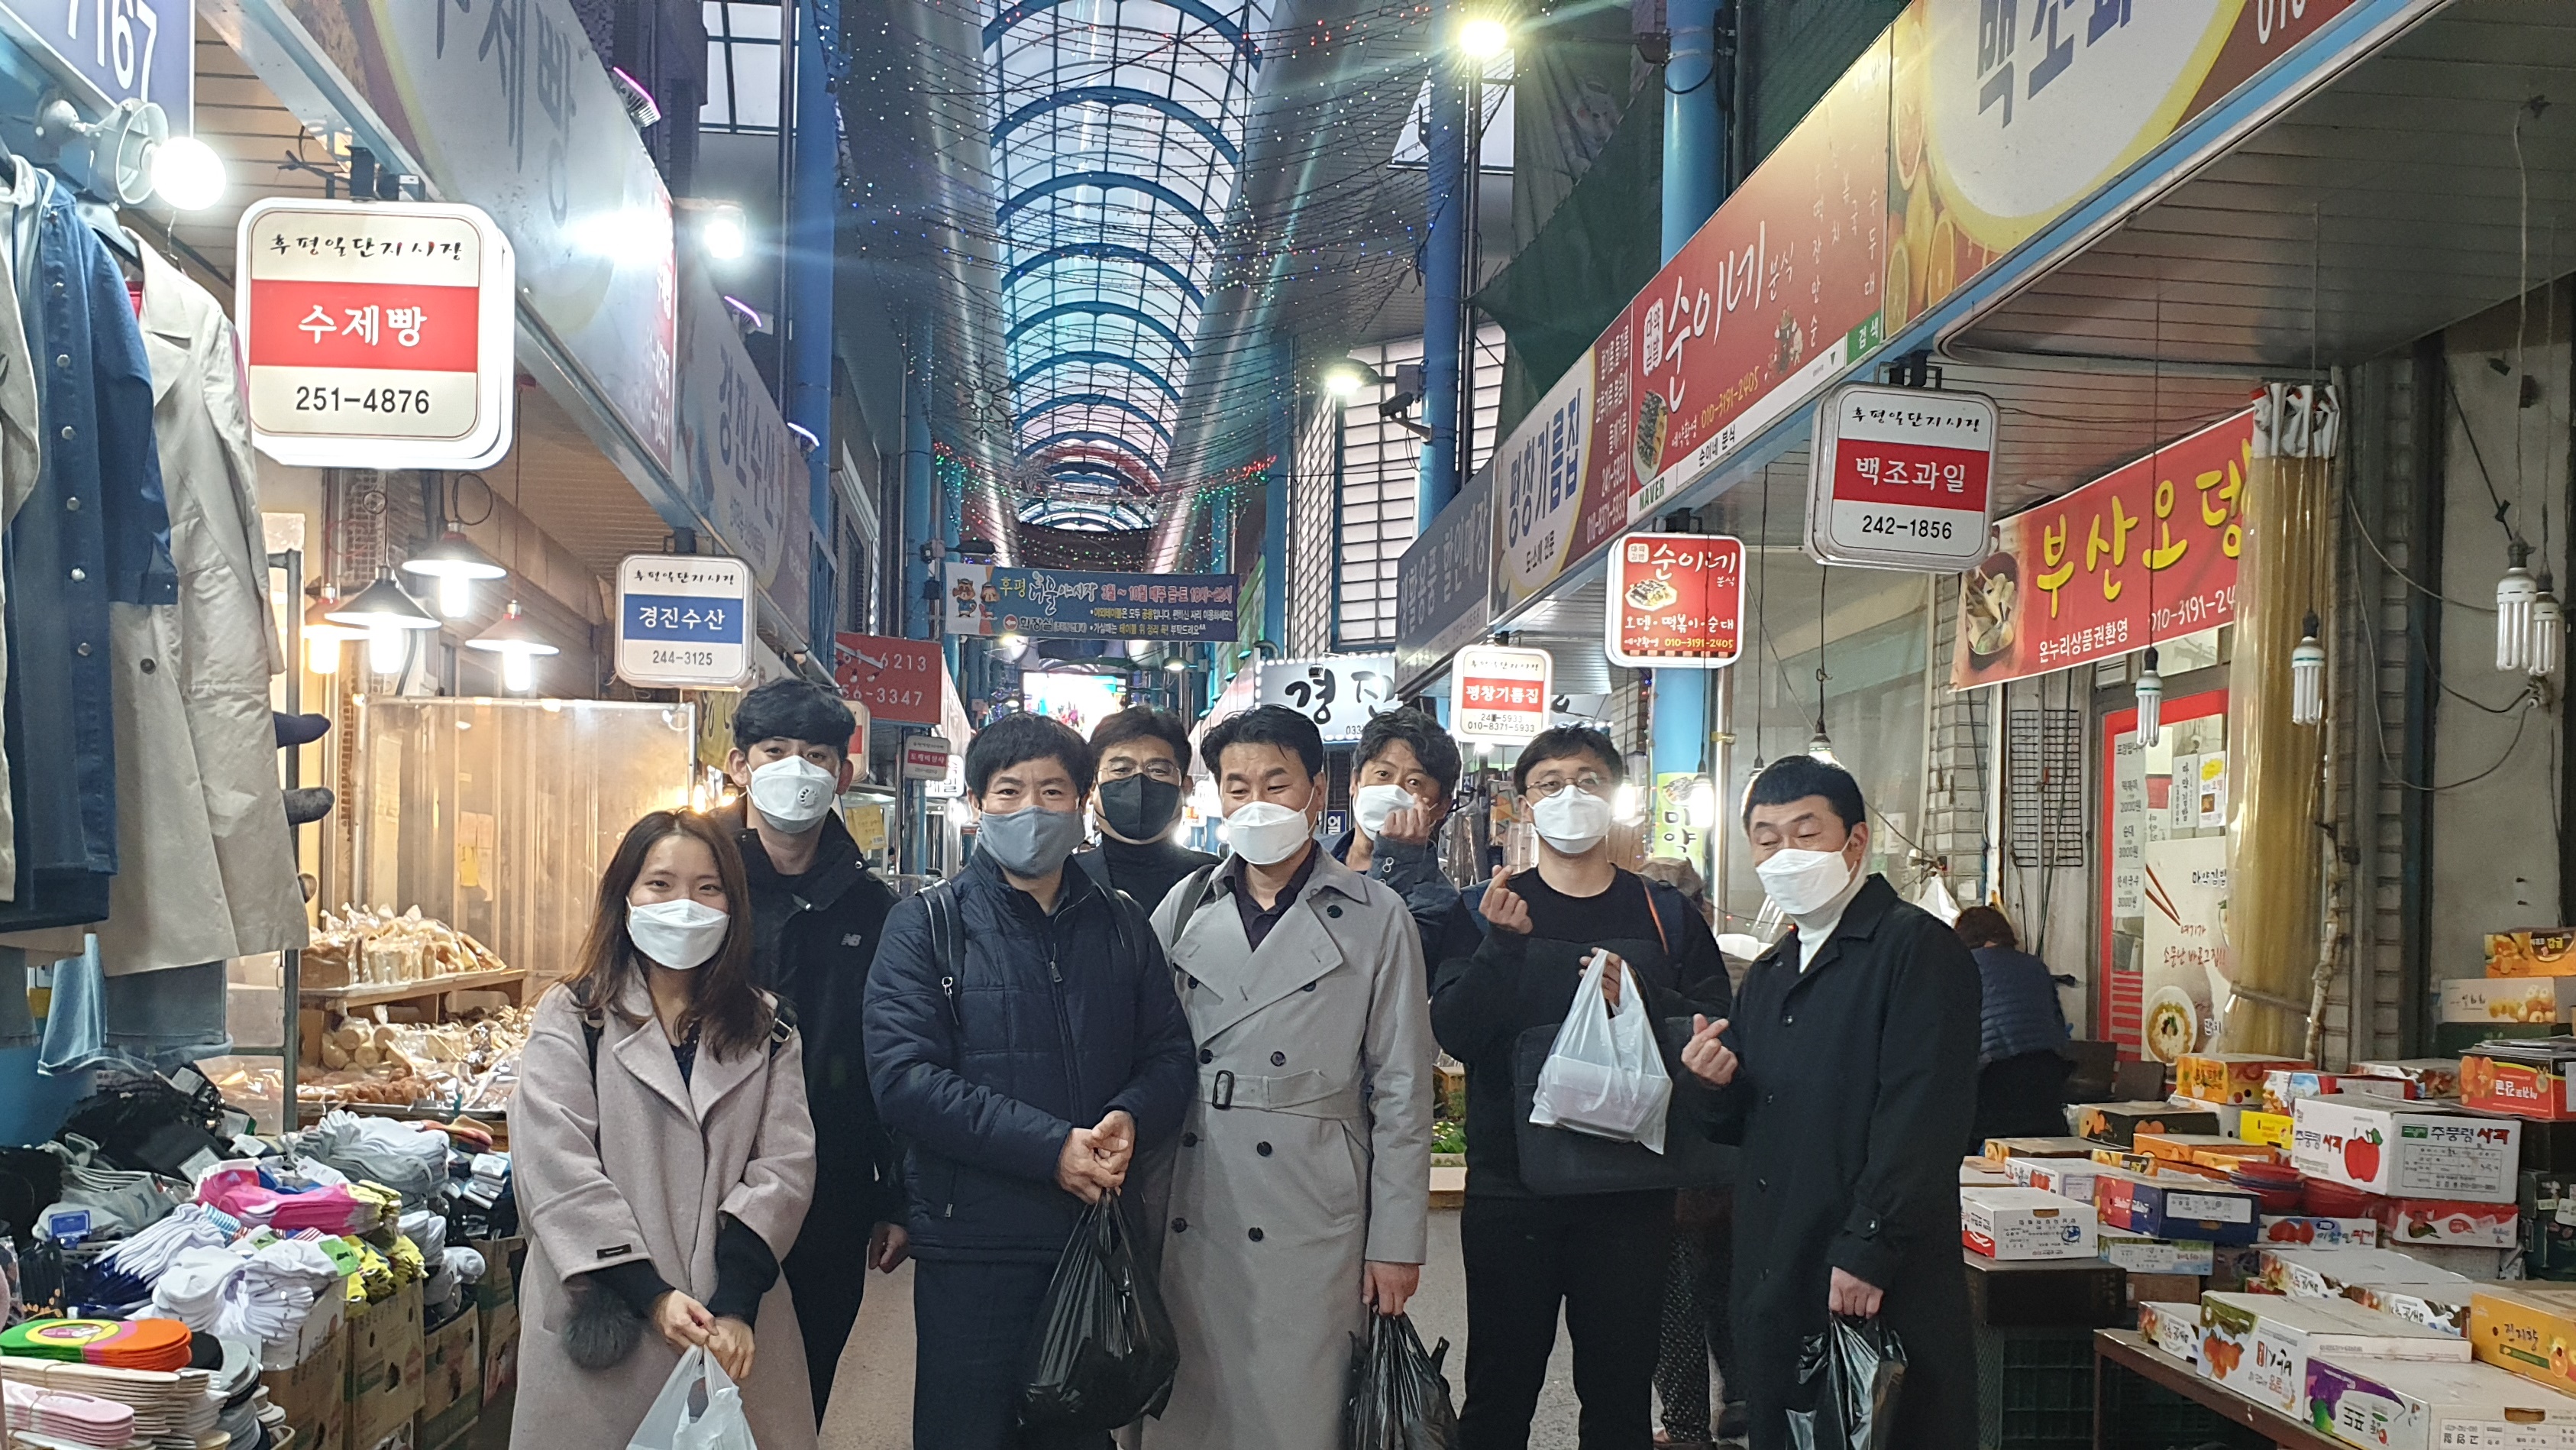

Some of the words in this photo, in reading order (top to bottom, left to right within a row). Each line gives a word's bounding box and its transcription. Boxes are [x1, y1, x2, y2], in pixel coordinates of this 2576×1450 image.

[298, 305, 428, 348] 수제빵
[1858, 316, 1879, 349] 검색
[296, 387, 431, 415] 251-4876
[1701, 365, 1759, 429] 010-3191-2405
[1698, 442, 1718, 468] 순이네
[1509, 387, 1582, 549] 평창기름집
[1856, 457, 1965, 493] 백조과일
[1639, 477, 1664, 511] NAVER
[1862, 515, 1952, 539] 242-1856
[1000, 577, 1026, 597] 후평
[638, 607, 726, 632] 경진수산
[1708, 616, 1734, 633] 순대
[1665, 638, 1734, 648] 010-3191-2405
[2039, 617, 2128, 663] 온누리상품권환영
[652, 650, 713, 666] 244-3125
[1466, 685, 1539, 704] 평창기름집
[1468, 721, 1535, 733] 010-8371-5933
[2181, 925, 2206, 937] 여기가
[2477, 1128, 2510, 1144] 사과
